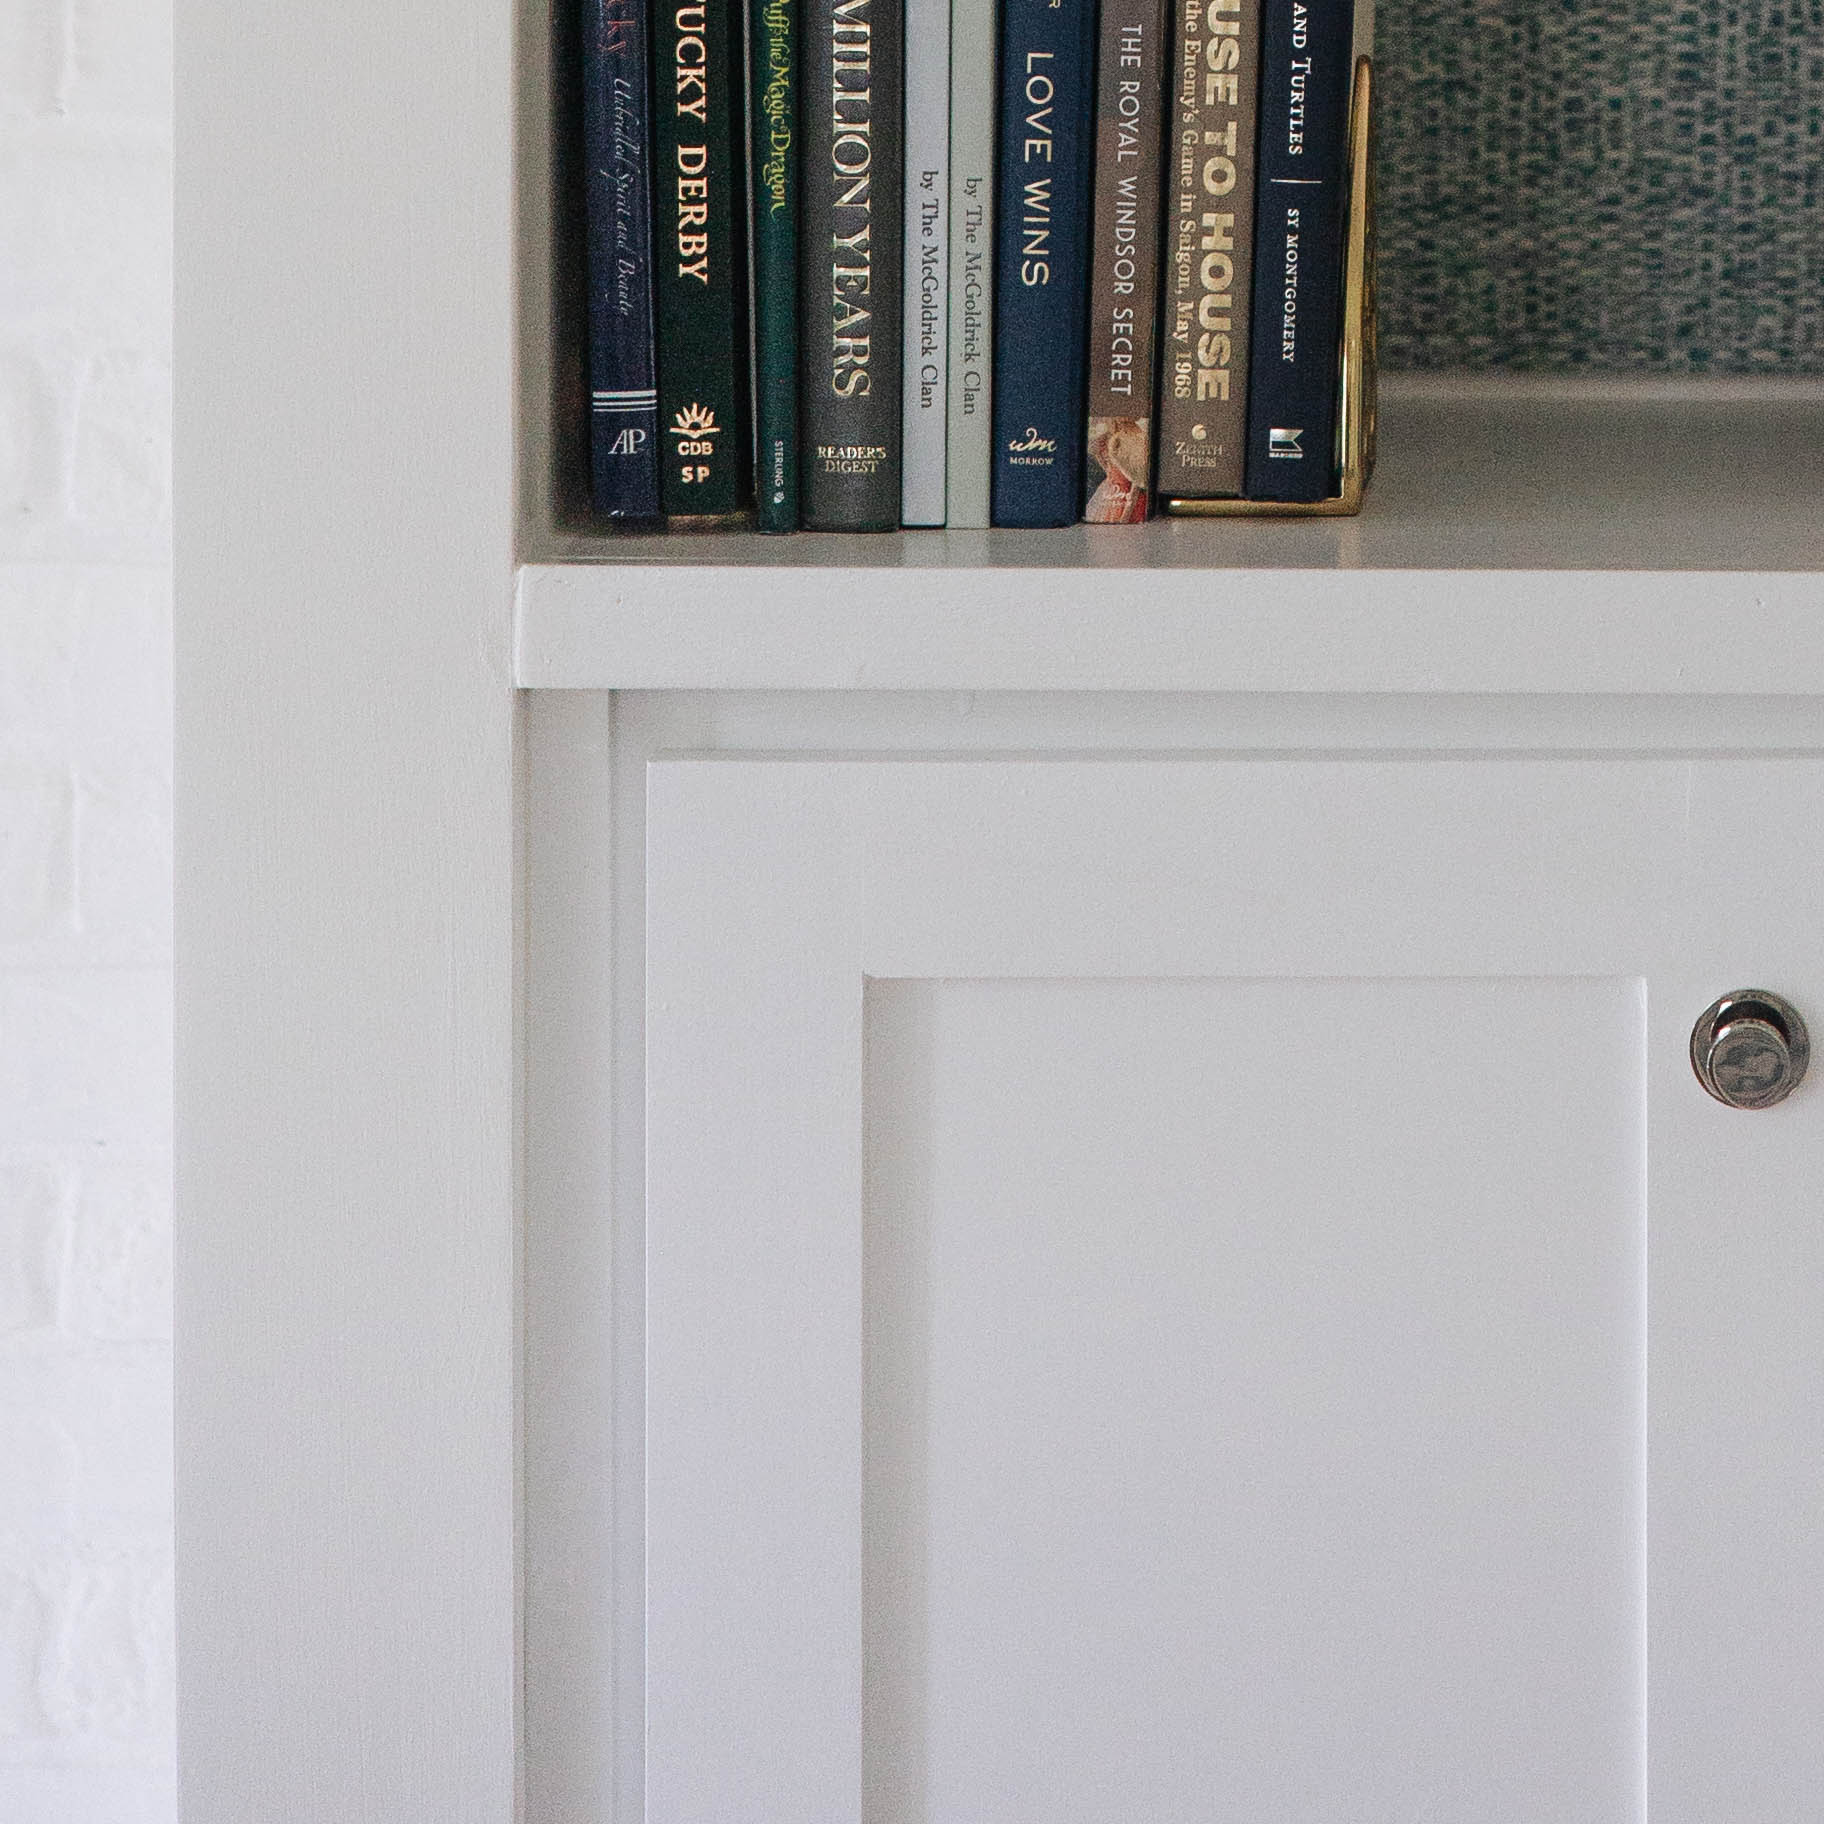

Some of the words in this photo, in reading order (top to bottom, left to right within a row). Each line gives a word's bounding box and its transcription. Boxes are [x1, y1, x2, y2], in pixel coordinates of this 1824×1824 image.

[1185, 2, 1203, 32] the
[1291, 2, 1309, 49] AND
[1120, 24, 1143, 66] THE
[763, 61, 790, 126] Magic
[1180, 40, 1201, 123] Enemy's
[613, 77, 641, 163] Unbridled
[1024, 53, 1053, 163] LOVE
[1117, 80, 1141, 163] ROYAL
[763, 128, 791, 222] Dragon
[922, 171, 939, 194] by
[1180, 130, 1198, 187] Game
[1201, 121, 1237, 196] TO
[600, 167, 634, 215] Spirit
[966, 177, 983, 200] by
[1181, 194, 1196, 213] in
[615, 219, 634, 252] and
[677, 144, 709, 286] DERBY
[920, 198, 939, 237] The
[965, 205, 982, 244] The
[1021, 178, 1051, 287] WINS
[1113, 175, 1138, 295] WINDSOR
[1286, 209, 1299, 232] SY
[1175, 219, 1196, 295] Saigon,
[831, 223, 871, 398] YEARS
[920, 245, 939, 356] McGoldrick
[963, 250, 982, 363] McGoldrick
[1172, 301, 1193, 343] May
[1196, 213, 1234, 401] HOUSE
[1281, 235, 1298, 364] MONTGOMERY
[1110, 307, 1134, 398] SECRET
[1174, 351, 1192, 398] 1968
[920, 364, 934, 409] Clan
[963, 371, 980, 416] Clan
[678, 441, 713, 456] CDB
[773, 440, 784, 488] STERLING
[817, 445, 887, 459] READER'S
[824, 459, 878, 473] DIGEST
[1009, 457, 1054, 465] MORROW
